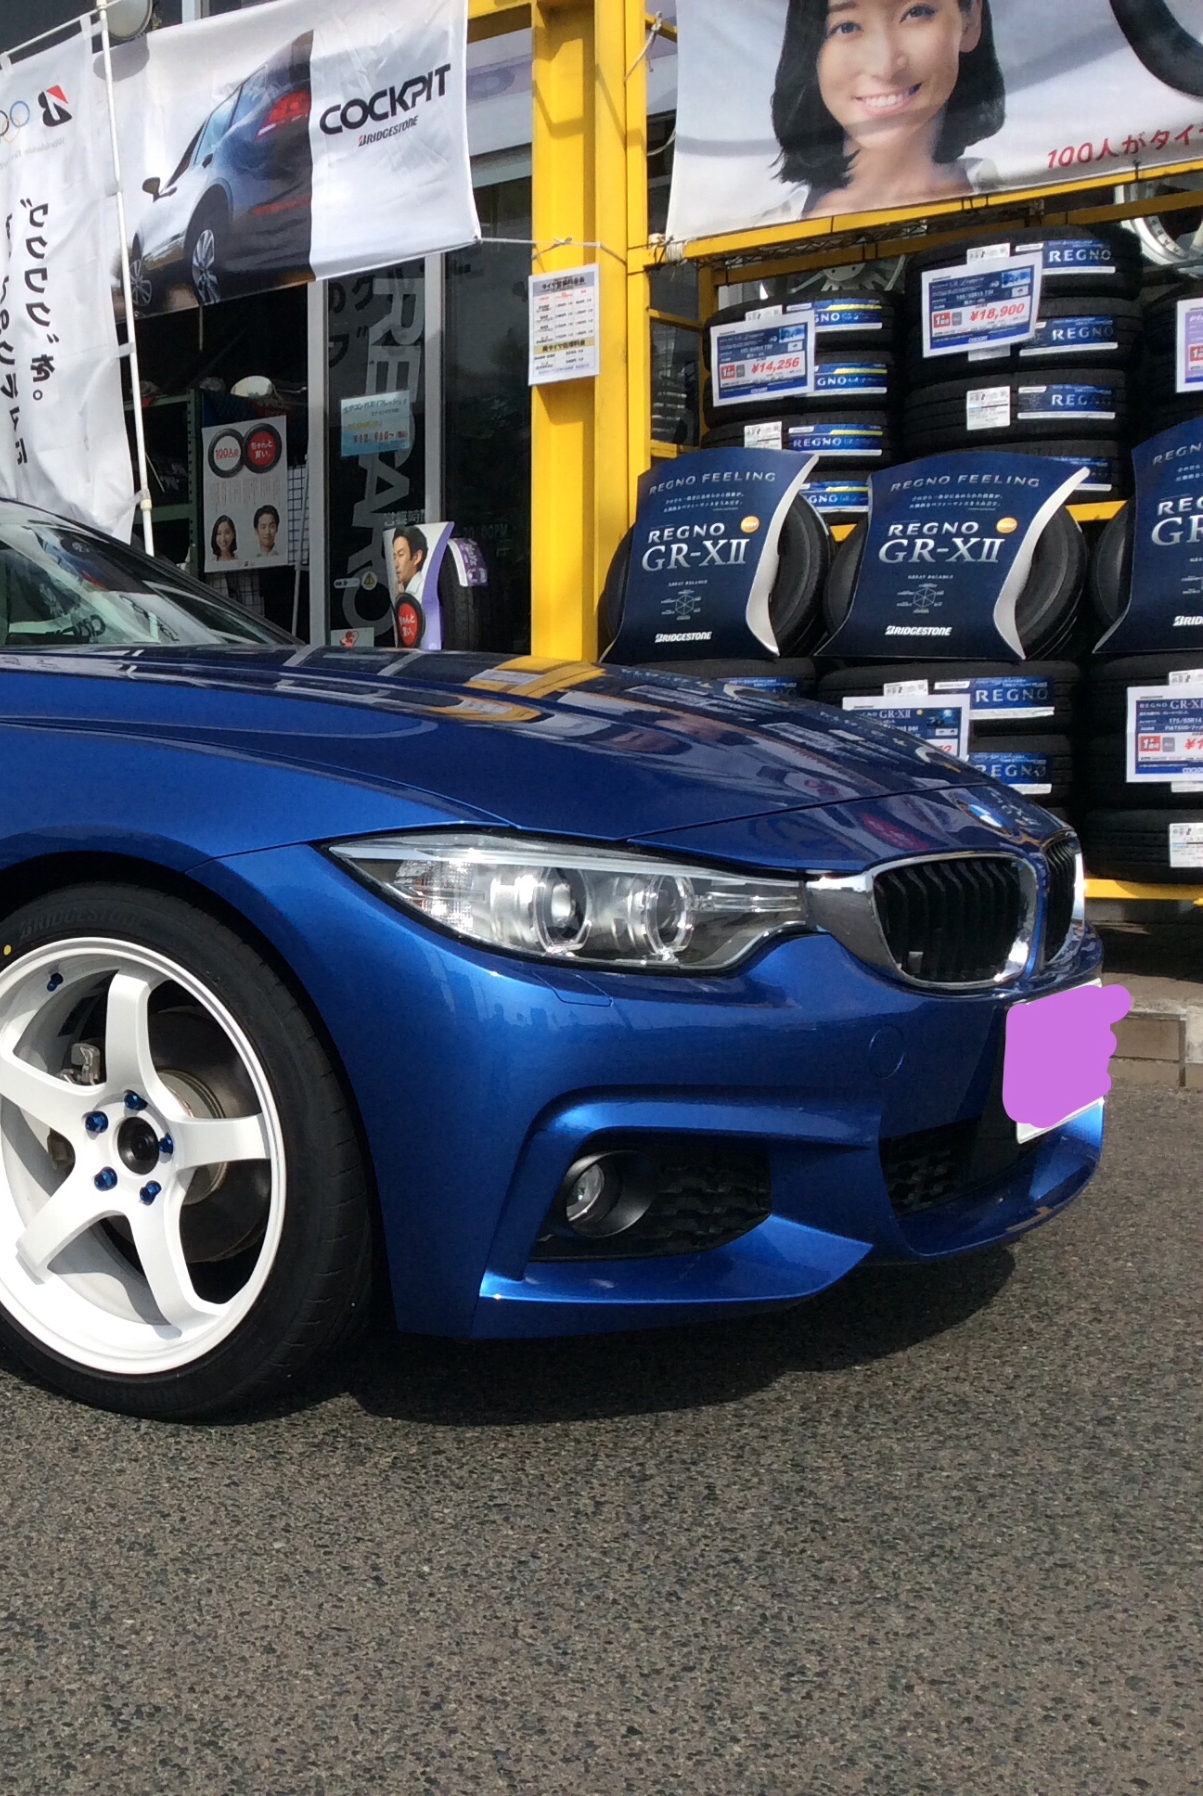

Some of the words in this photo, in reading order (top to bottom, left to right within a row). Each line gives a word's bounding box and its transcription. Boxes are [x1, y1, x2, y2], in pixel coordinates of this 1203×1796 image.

[319, 63, 451, 135] COCKPIT
[358, 115, 419, 147] BRIDGESTONE
[1048, 122, 1203, 169] 100人がタイ
[1049, 249, 1111, 262] REGNO
[815, 312, 840, 323] GNO
[970, 303, 1025, 321] ¥18,900
[1052, 327, 1114, 341] REGNO
[751, 357, 800, 374] ¥14,256
[817, 372, 847, 386] GNO
[793, 437, 842, 448] REGNO
[1152, 442, 1203, 465] REGN
[649, 475, 696, 495] REGNO
[701, 471, 776, 483] FEELING
[890, 475, 950, 492] REGNO
[957, 474, 1040, 488] FEELING
[807, 493, 838, 504] GNO
[648, 522, 725, 543] REGNO
[888, 521, 979, 537] REGNO
[655, 632, 712, 643] BRIDGESTONE
[885, 625, 952, 636] BRIDGESTONE
[975, 688, 1048, 702] REGNO
